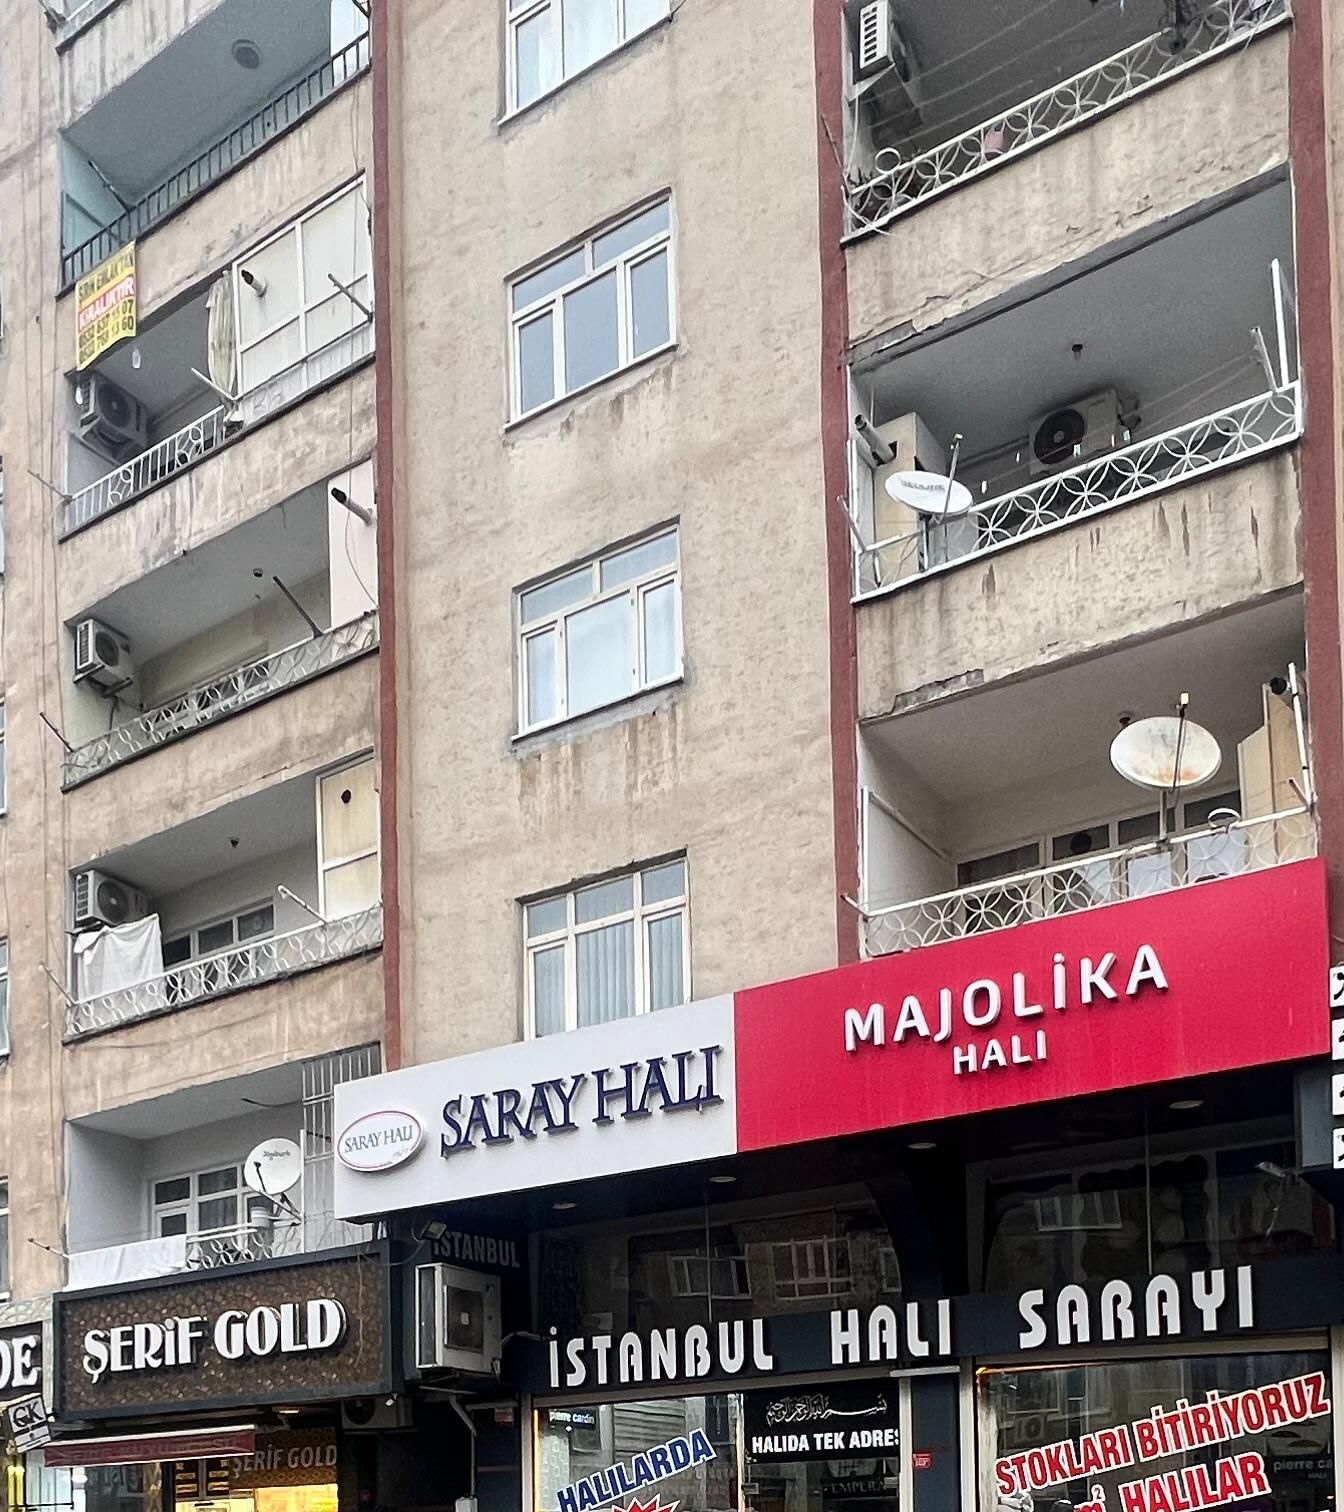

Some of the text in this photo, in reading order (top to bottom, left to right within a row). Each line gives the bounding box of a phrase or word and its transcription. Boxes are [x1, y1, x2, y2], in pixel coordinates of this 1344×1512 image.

[843, 944, 1169, 1051] MAJOLİKA
[953, 1029, 1047, 1075] HALI
[440, 1045, 724, 1159] SARAY HALI
[344, 1131, 382, 1154] SARAY
[83, 1299, 348, 1384] ŞERİF GOLD
[549, 1265, 1254, 1388] İSTANBUL HALI SARAYI
[287, 1445, 338, 1469] GOLD
[751, 1434, 810, 1454] HALIDA
[813, 1431, 845, 1450] TEK
[996, 1371, 1331, 1498] STOKLARI BİTİRİYORUZ
[1273, 1460, 1314, 1473] pierre
